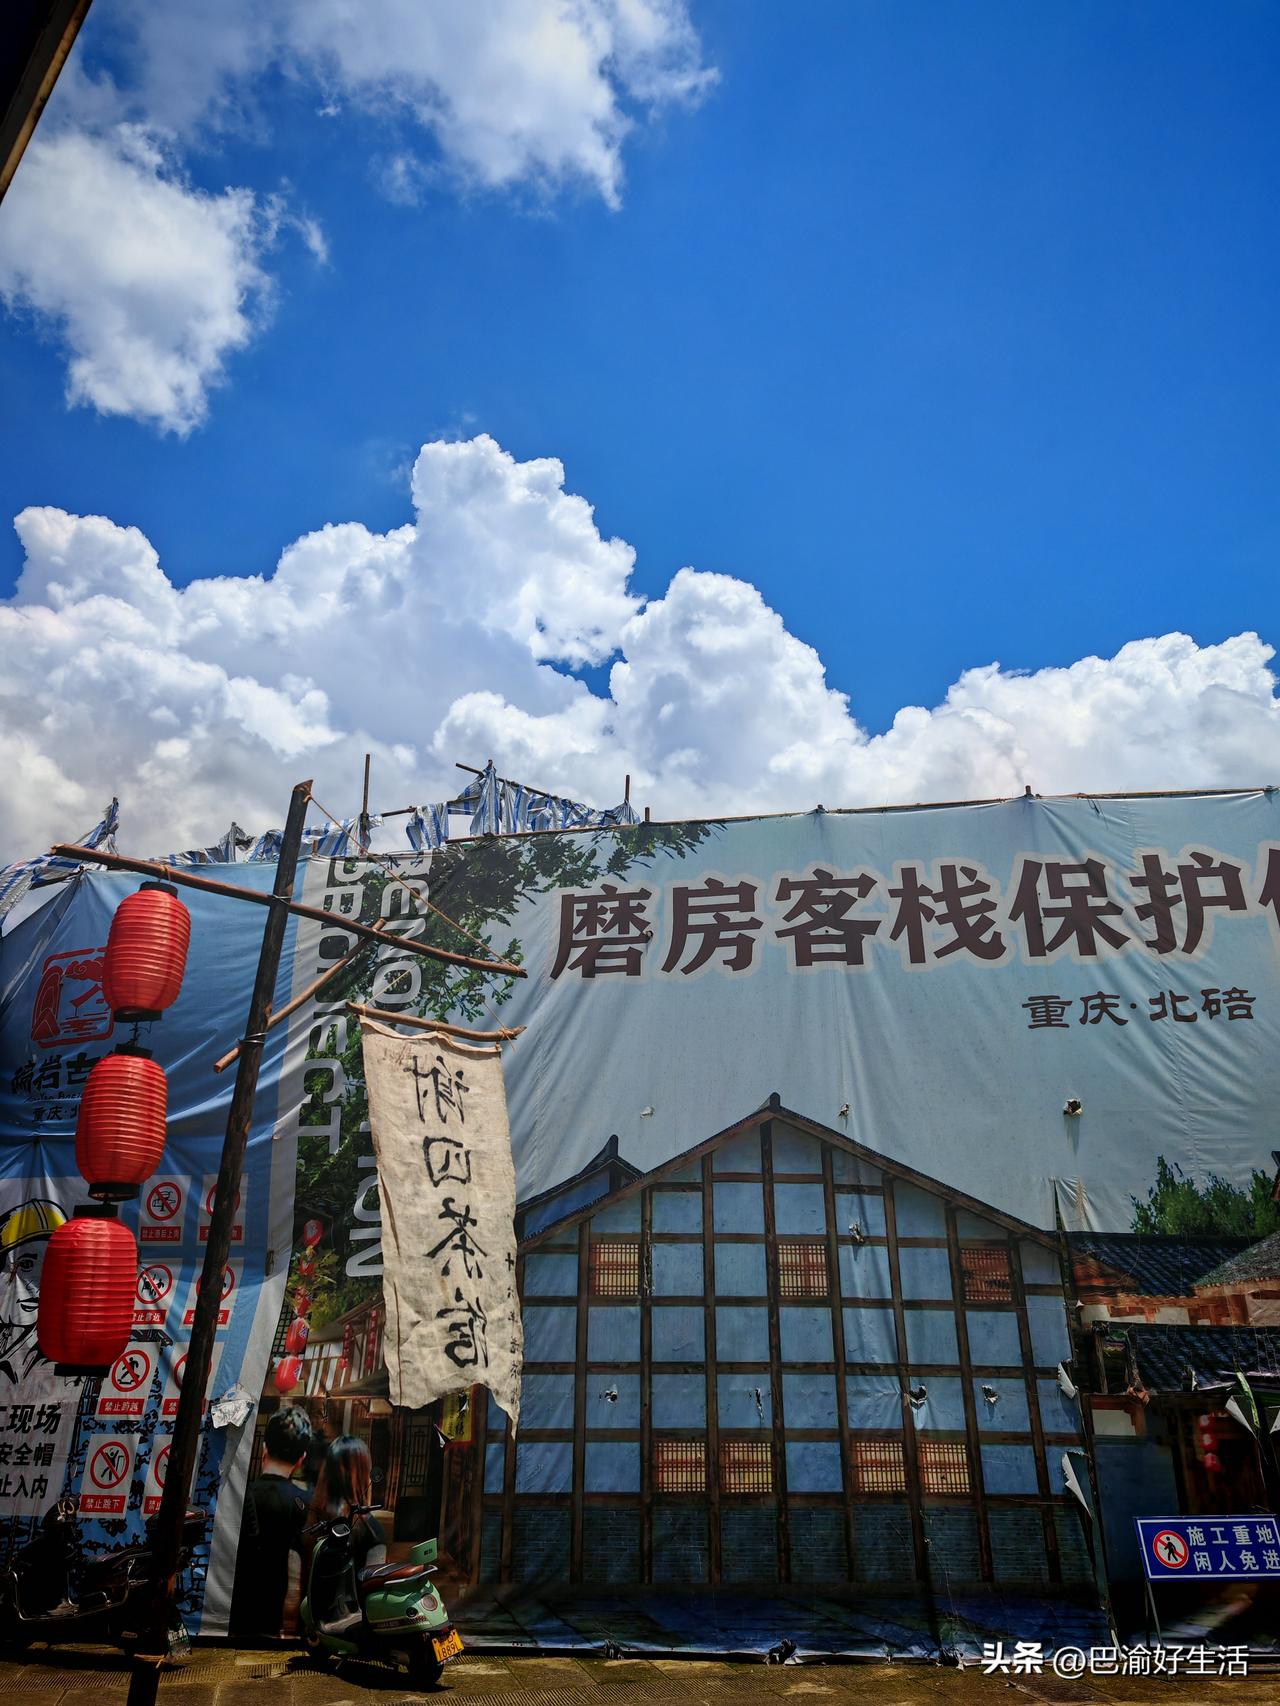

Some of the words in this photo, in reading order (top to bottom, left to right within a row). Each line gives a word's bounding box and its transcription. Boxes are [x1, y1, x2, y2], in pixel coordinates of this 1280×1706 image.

[1022, 987, 1256, 1029] 重庆·北碚
[0, 1442, 55, 1467] 安全帽
[1186, 1524, 1275, 1546] 施工重地
[1193, 1549, 1280, 1572] 闲人免进
